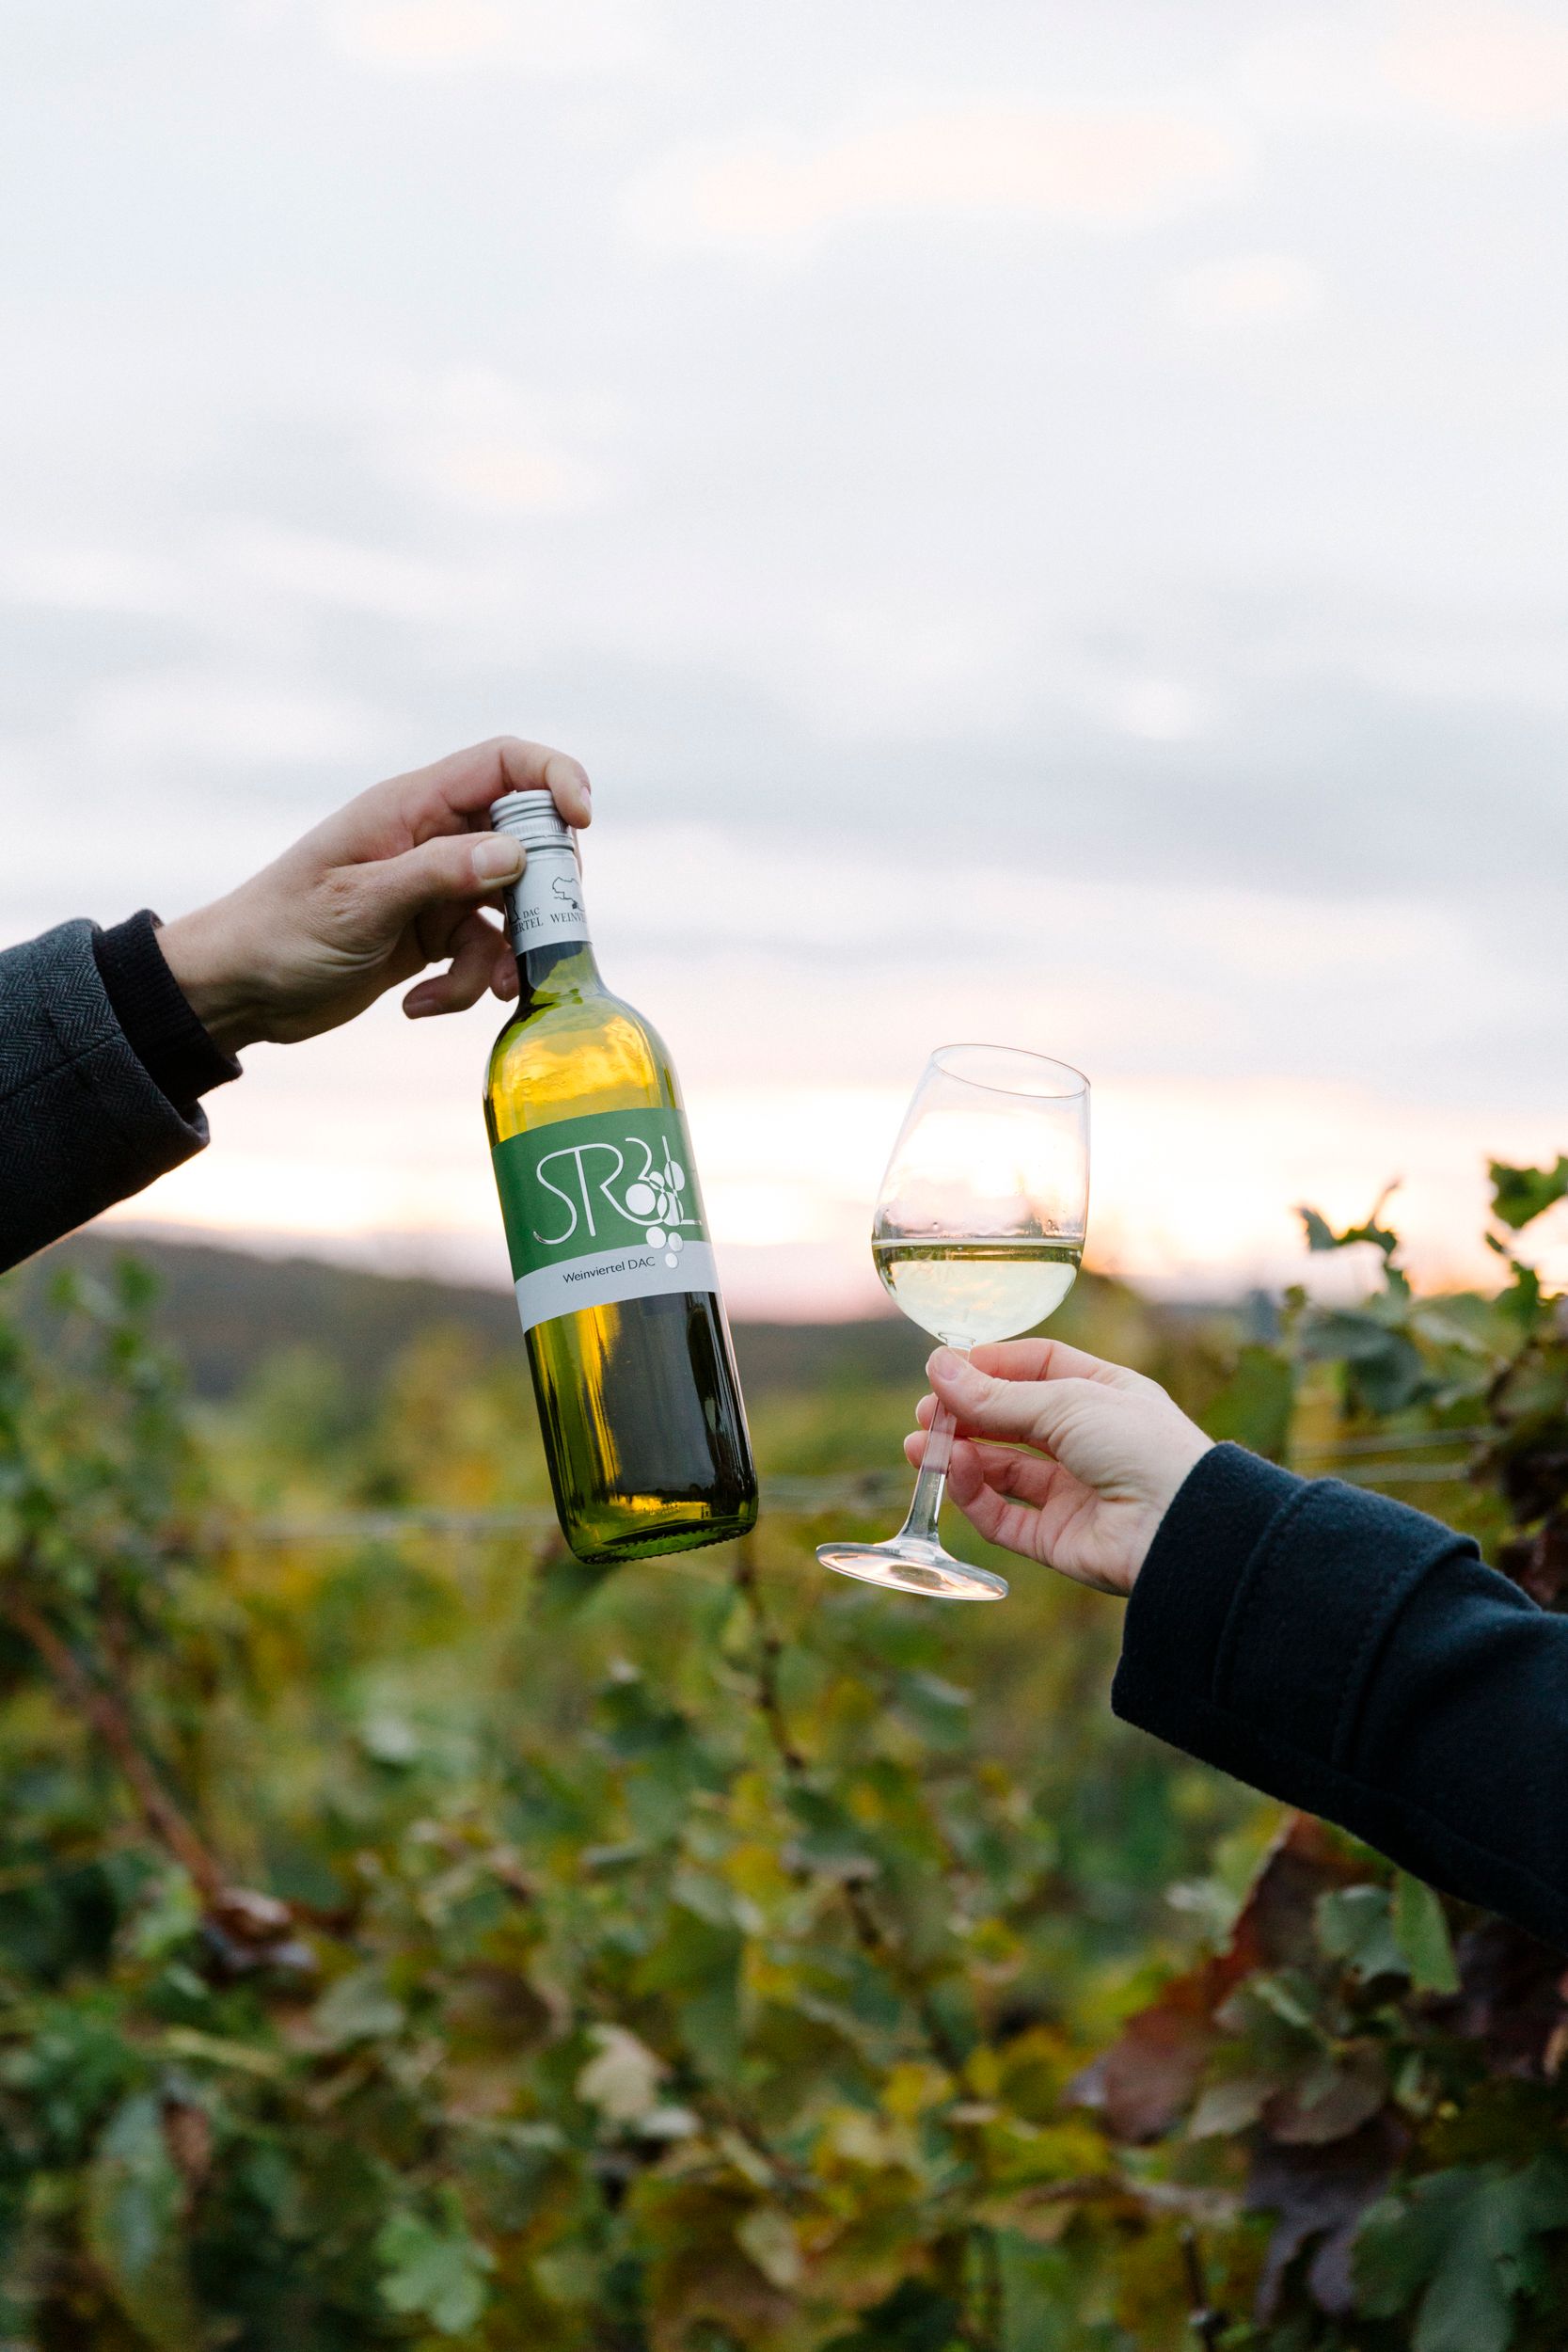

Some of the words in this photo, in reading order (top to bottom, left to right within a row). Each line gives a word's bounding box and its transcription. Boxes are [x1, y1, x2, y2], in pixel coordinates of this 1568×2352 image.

[523, 907, 540, 919] DAC
[562, 1261, 626, 1283] Weinviertel
[627, 1256, 656, 1270] DAC
